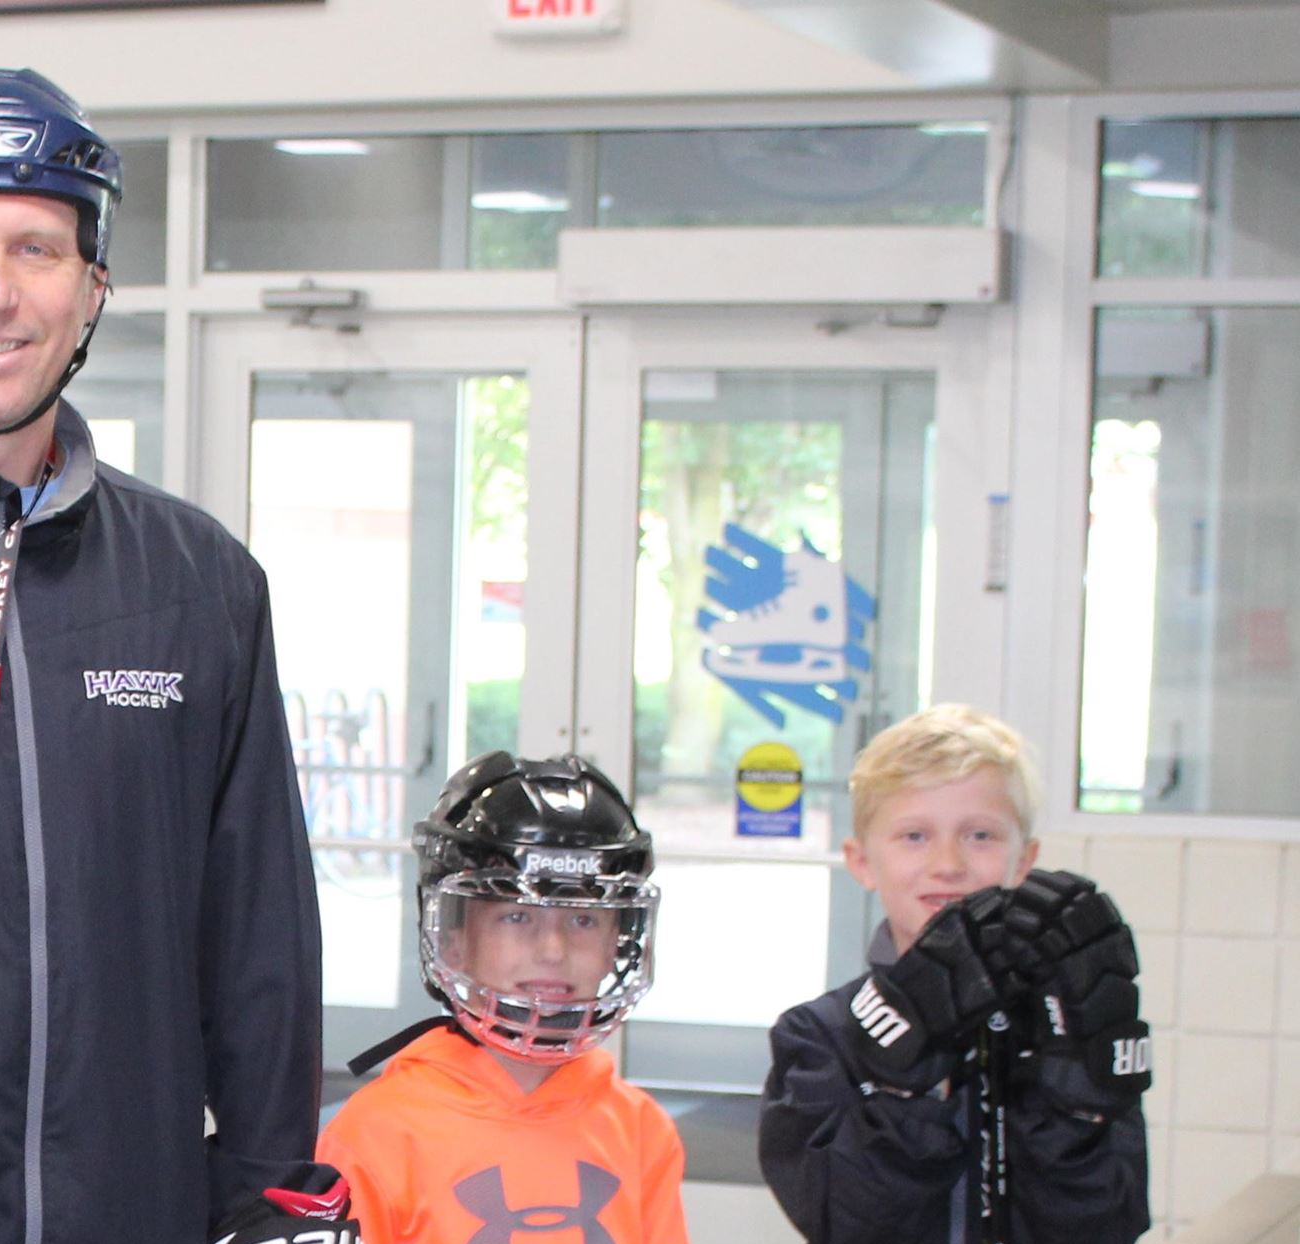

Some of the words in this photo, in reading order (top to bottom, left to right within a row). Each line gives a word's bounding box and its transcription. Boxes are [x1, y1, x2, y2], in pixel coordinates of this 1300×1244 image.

[83, 670, 183, 702] HAWK
[106, 692, 168, 709] HOCKEY
[526, 853, 601, 875] Reebok
